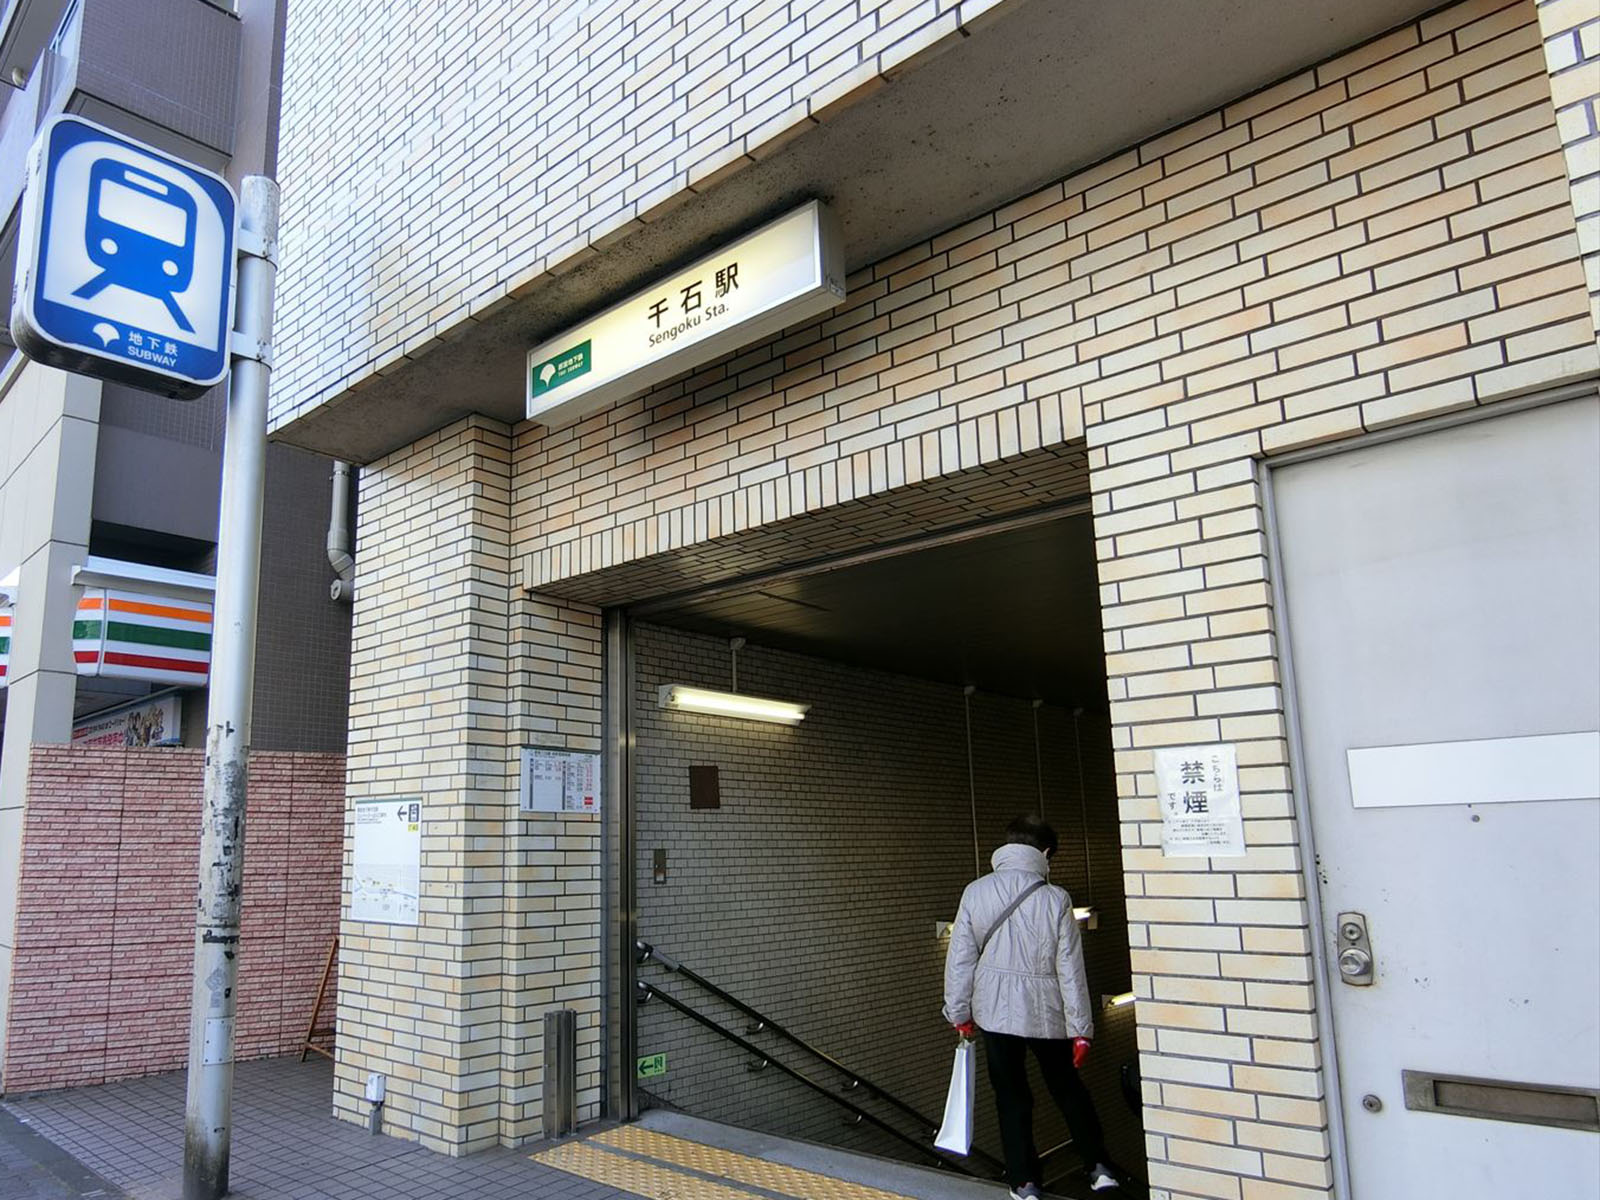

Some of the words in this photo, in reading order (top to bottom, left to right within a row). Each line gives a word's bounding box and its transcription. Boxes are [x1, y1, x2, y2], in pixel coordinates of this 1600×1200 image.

[647, 262, 739, 329] 千石駅
[128, 330, 178, 357] 地下鉄
[648, 315, 702, 348] Sengoku
[705, 303, 730, 321] Sta.
[127, 345, 177, 367] SUBWAY
[1181, 760, 1209, 814] 禁煙
